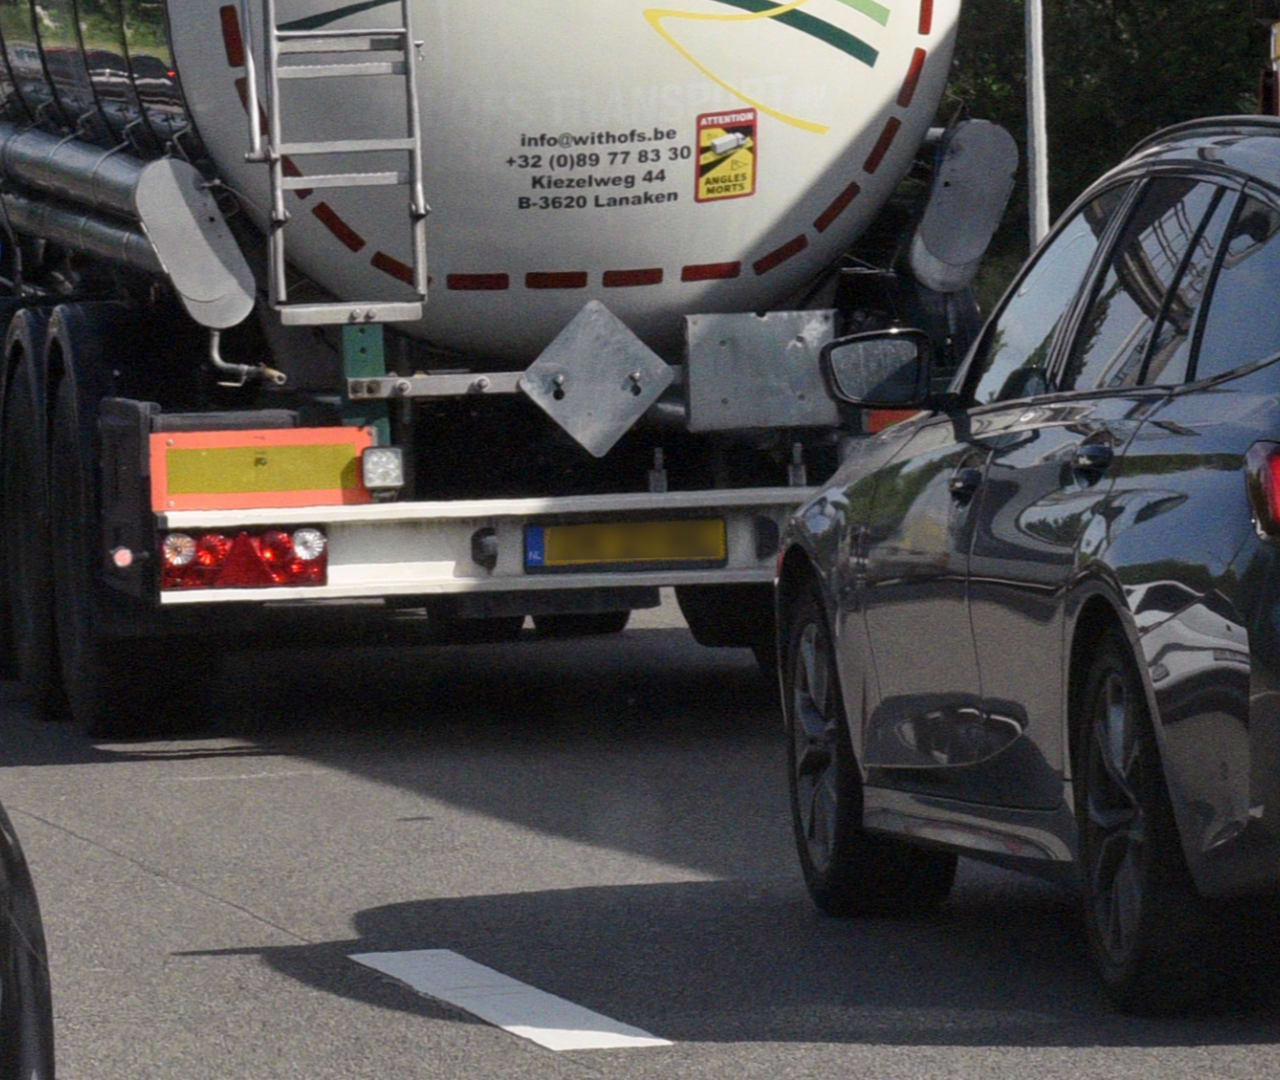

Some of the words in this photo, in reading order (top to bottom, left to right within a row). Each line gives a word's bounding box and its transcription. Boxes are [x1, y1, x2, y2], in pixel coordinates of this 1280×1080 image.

[521, 128, 677, 148] info@withofs.be
[506, 153, 542, 169] +32
[549, 153, 600, 171] (0)89
[608, 151, 630, 165] 77
[638, 148, 661, 164] 83
[668, 145, 691, 161] 30
[531, 173, 636, 190] Kiezelweg
[642, 168, 666, 183] 44
[704, 173, 747, 186] ANGLES
[706, 183, 745, 195] MORTS
[518, 195, 588, 209] B-3620
[594, 191, 678, 208] Lanaken
